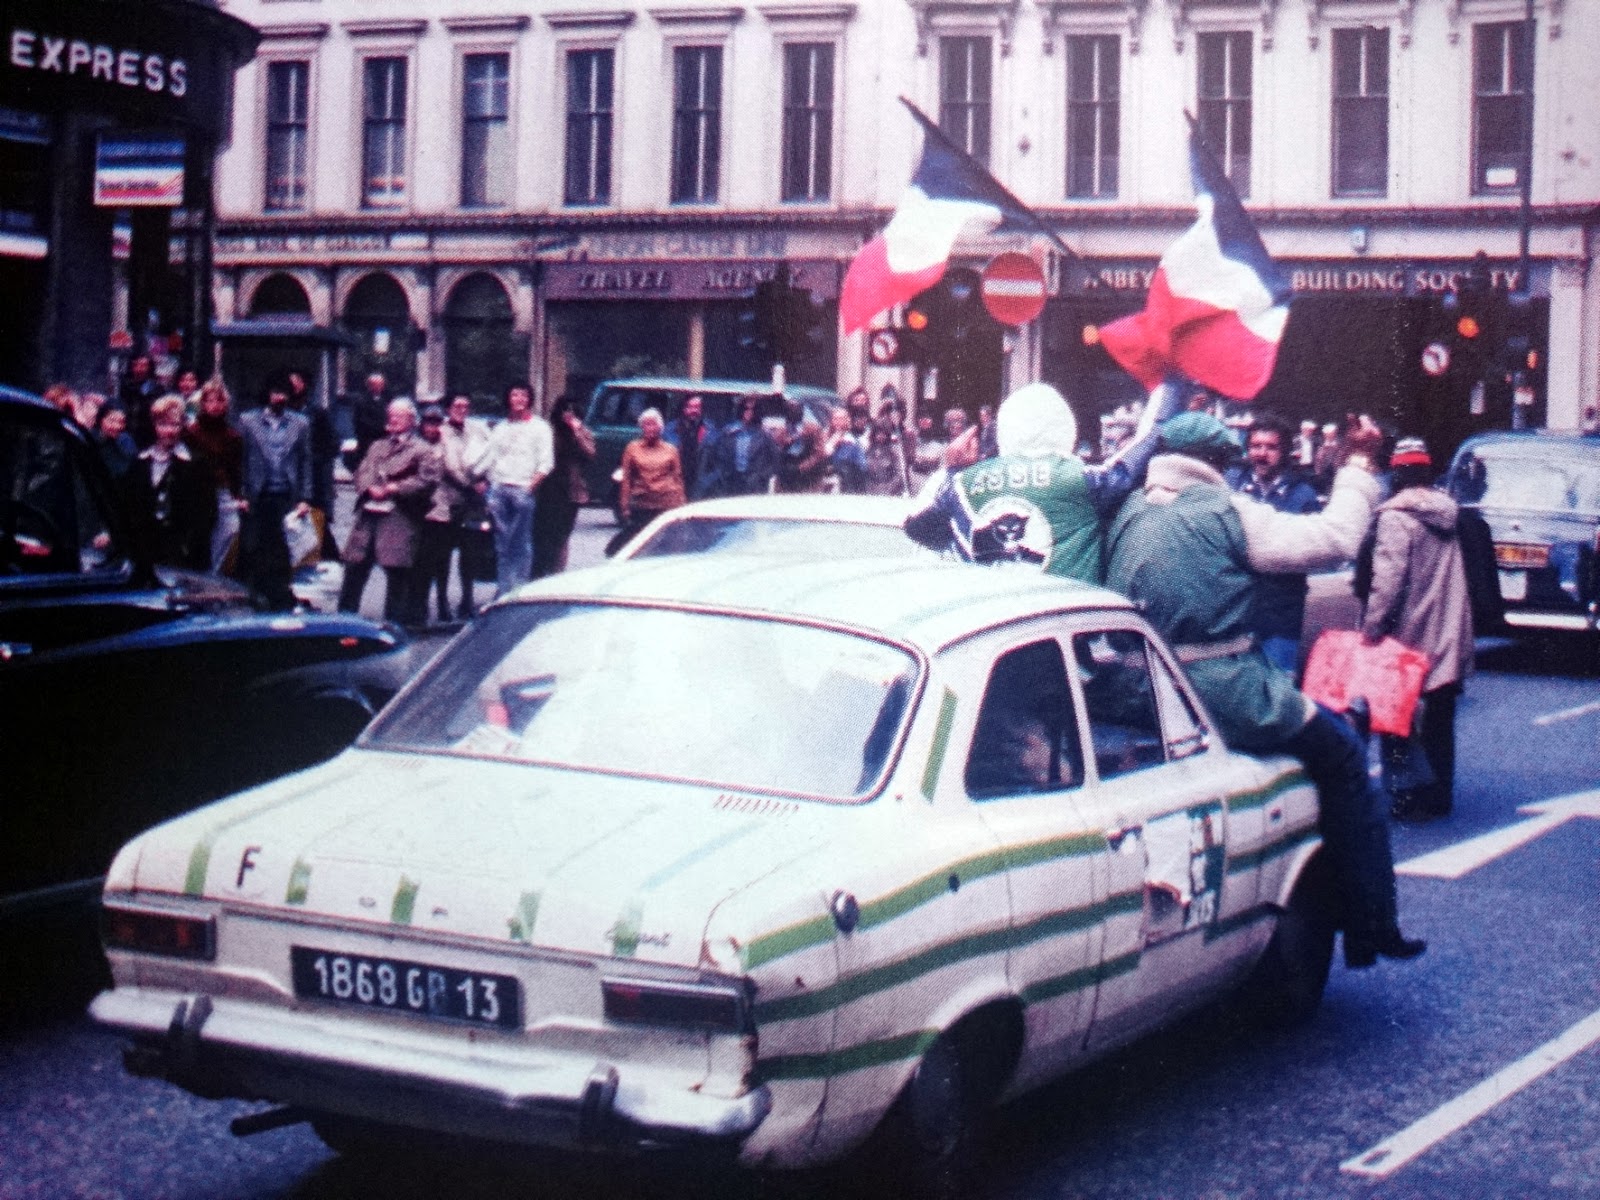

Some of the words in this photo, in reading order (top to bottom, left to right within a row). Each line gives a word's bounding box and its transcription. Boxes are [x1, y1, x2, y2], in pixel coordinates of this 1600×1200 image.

[10, 28, 188, 98] EXPRESS
[1291, 270, 1403, 292] BUILDING
[236, 845, 263, 889] F
[313, 956, 398, 1006] 1868
[457, 976, 501, 1022] 13
